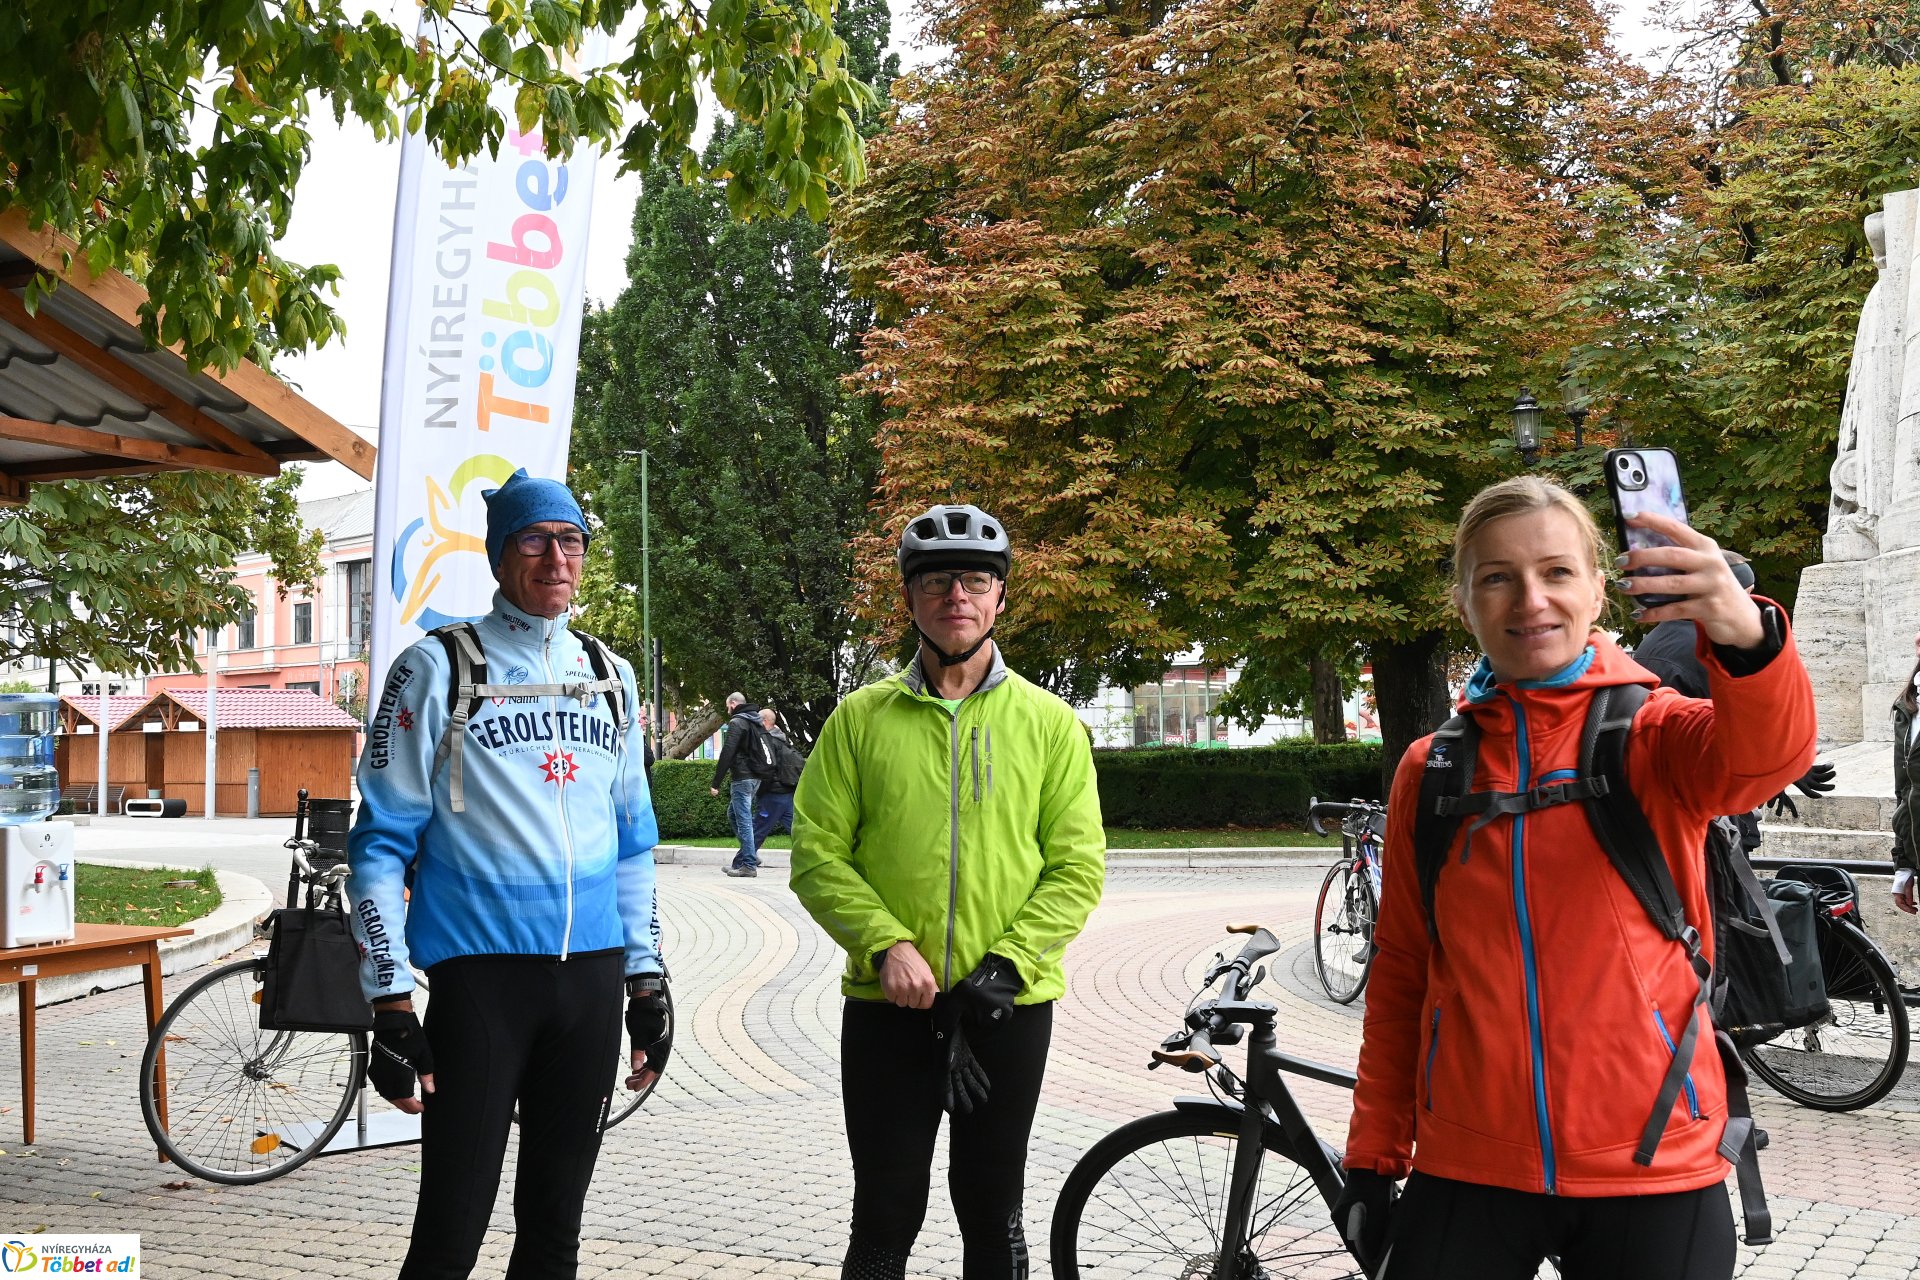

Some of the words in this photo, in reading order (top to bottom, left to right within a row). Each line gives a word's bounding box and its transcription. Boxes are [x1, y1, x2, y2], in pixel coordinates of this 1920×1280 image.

[371, 666, 414, 770] GEROLSTEINER
[469, 711, 618, 757] GEROLSTEINER
[358, 898, 395, 989] GEROLSTEINER
